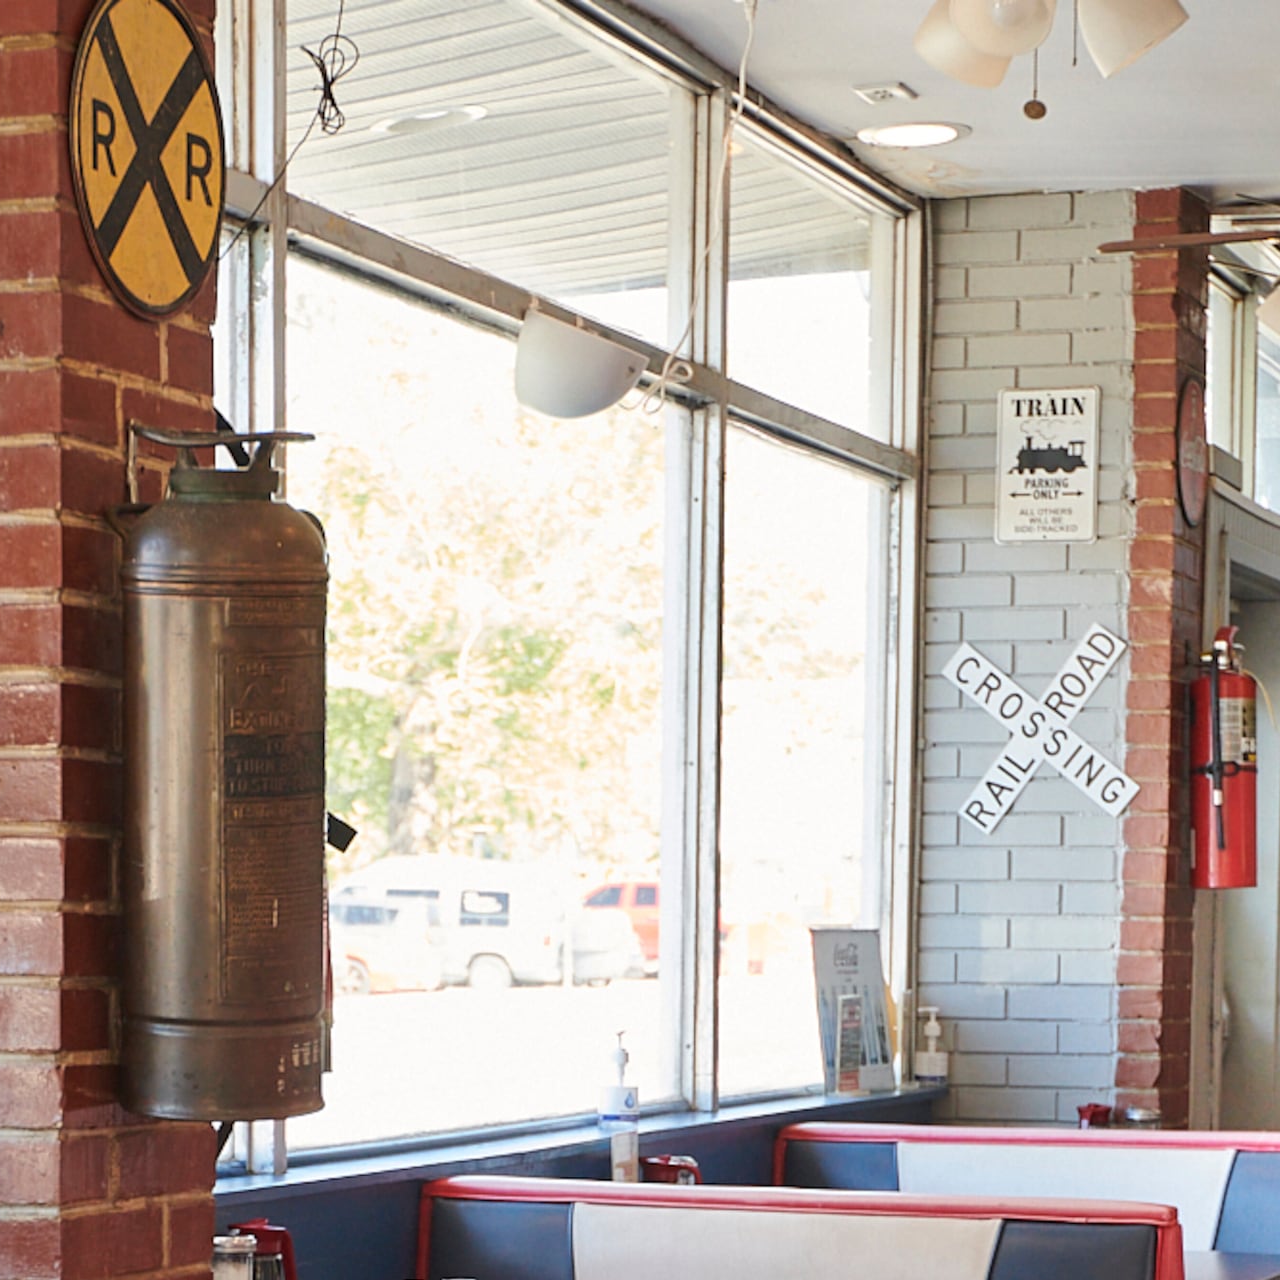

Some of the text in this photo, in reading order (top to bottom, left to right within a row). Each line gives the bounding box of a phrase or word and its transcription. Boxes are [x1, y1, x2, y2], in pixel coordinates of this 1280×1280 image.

[92, 97, 212, 208] R R
[1012, 396, 1086, 417] TRAIN
[1024, 478, 1069, 489] PARKING
[1033, 490, 1059, 499] ONLY
[1019, 507, 1073, 516] ALL OTHERS
[956, 656, 1126, 804] CROSSING
[965, 631, 1116, 828] RAIL ROAD
